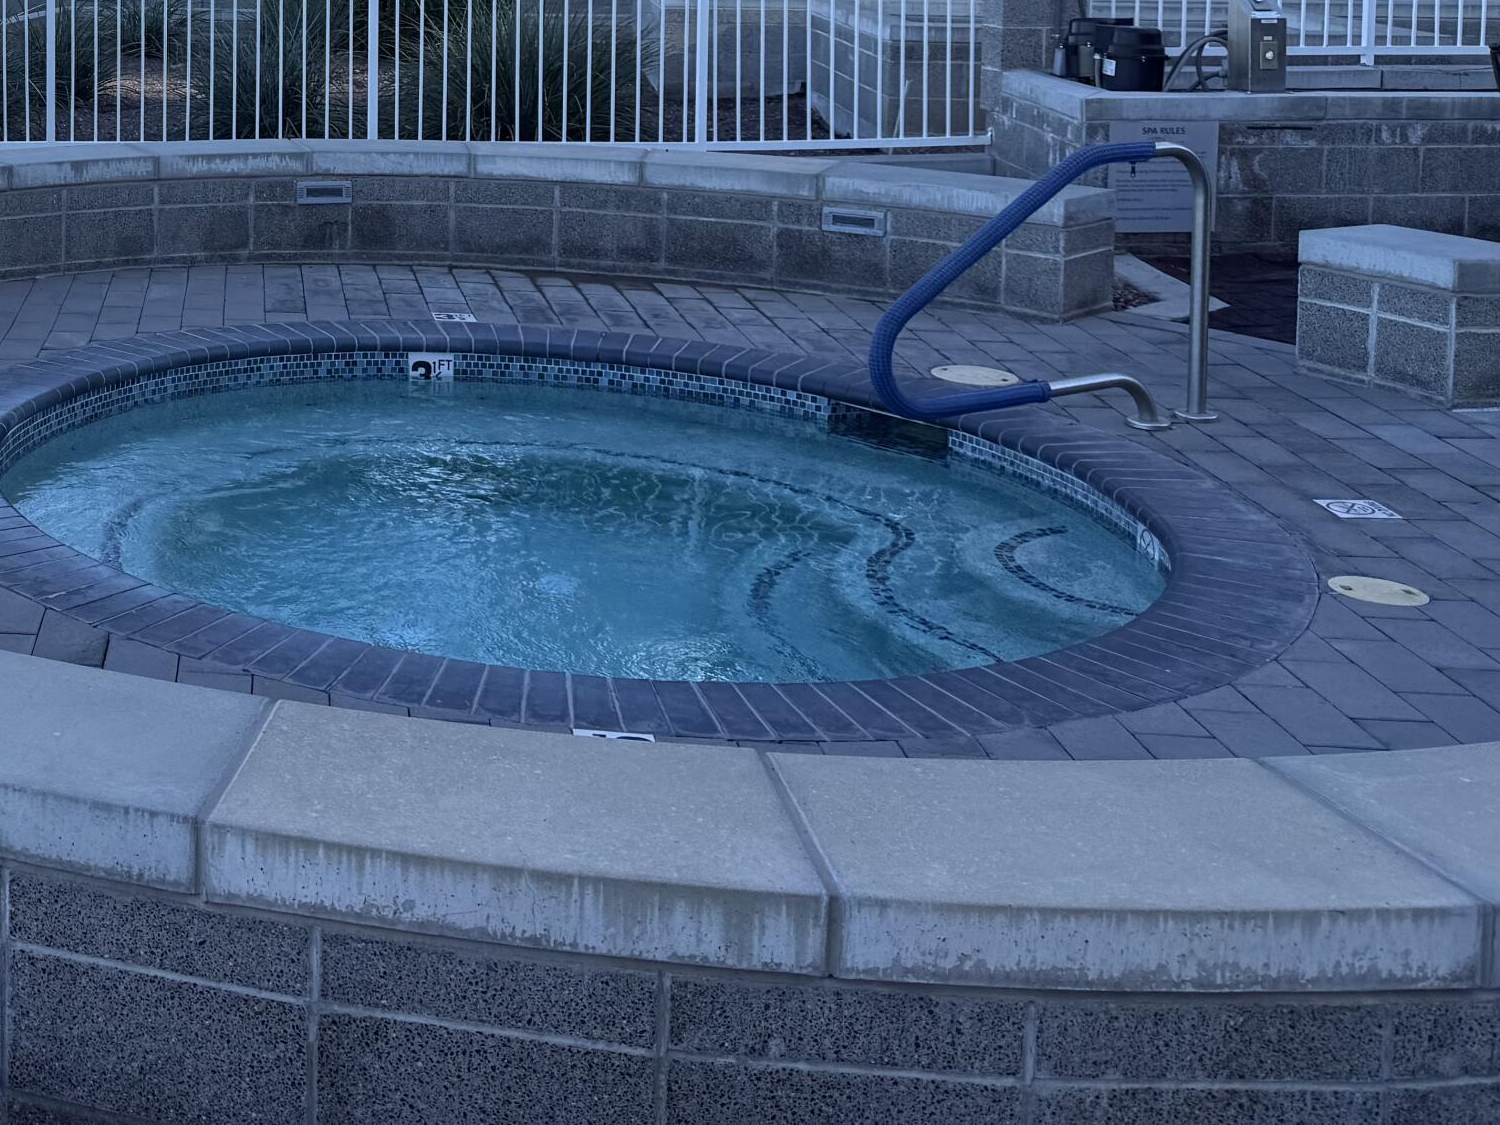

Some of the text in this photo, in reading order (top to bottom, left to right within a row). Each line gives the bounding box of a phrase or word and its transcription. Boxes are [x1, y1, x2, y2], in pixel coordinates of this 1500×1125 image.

[1142, 127, 1186, 135] SPA RULES
[438, 359, 453, 371] FT
